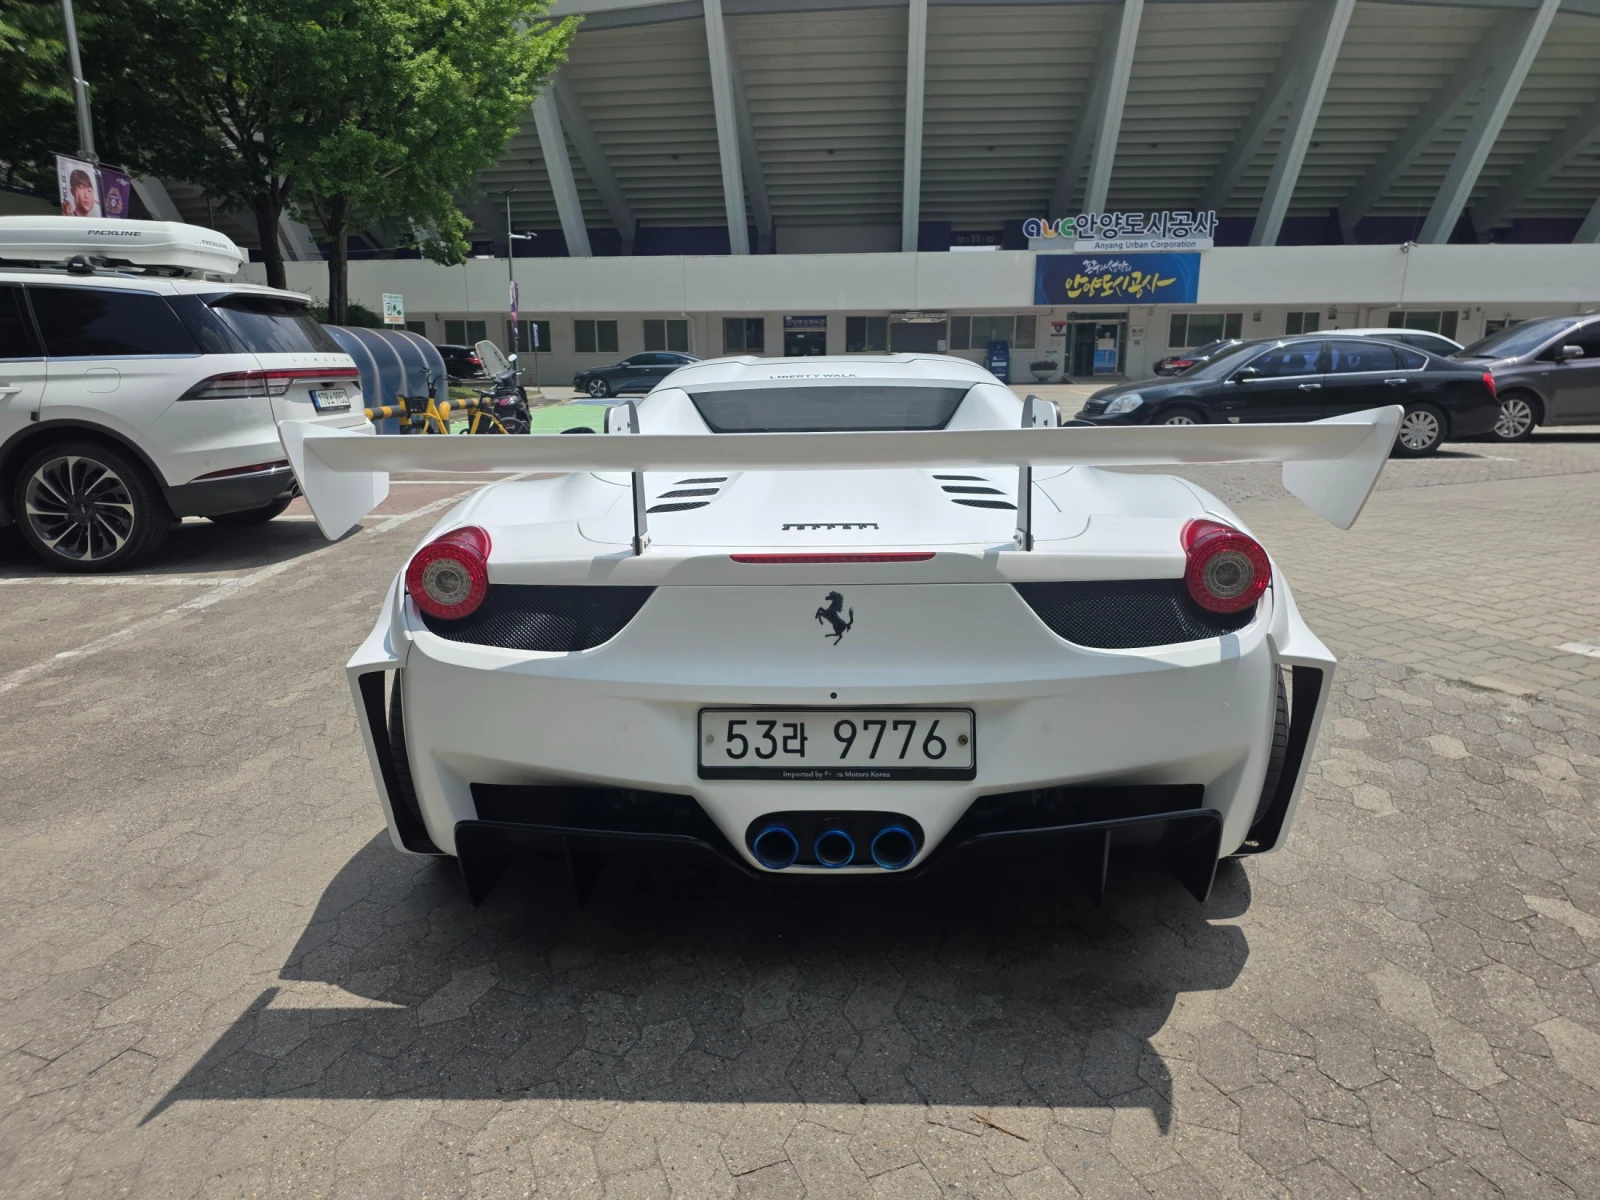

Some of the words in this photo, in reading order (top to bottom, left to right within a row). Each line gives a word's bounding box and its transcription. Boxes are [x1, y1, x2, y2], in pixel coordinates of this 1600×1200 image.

[87, 229, 142, 237] PACKLINE
[1075, 210, 1219, 240] 안양도시공사
[1094, 241, 1124, 250] Anyang
[1126, 240, 1149, 249] Urban
[1150, 240, 1196, 249] Corporation
[1064, 271, 1177, 299] 안양도시공사
[725, 719, 809, 760] 53라
[833, 719, 948, 760] 9776
[782, 770, 814, 779] Imported
[815, 770, 823, 779] by
[844, 770, 869, 778] Motors
[870, 770, 891, 778] Korea
